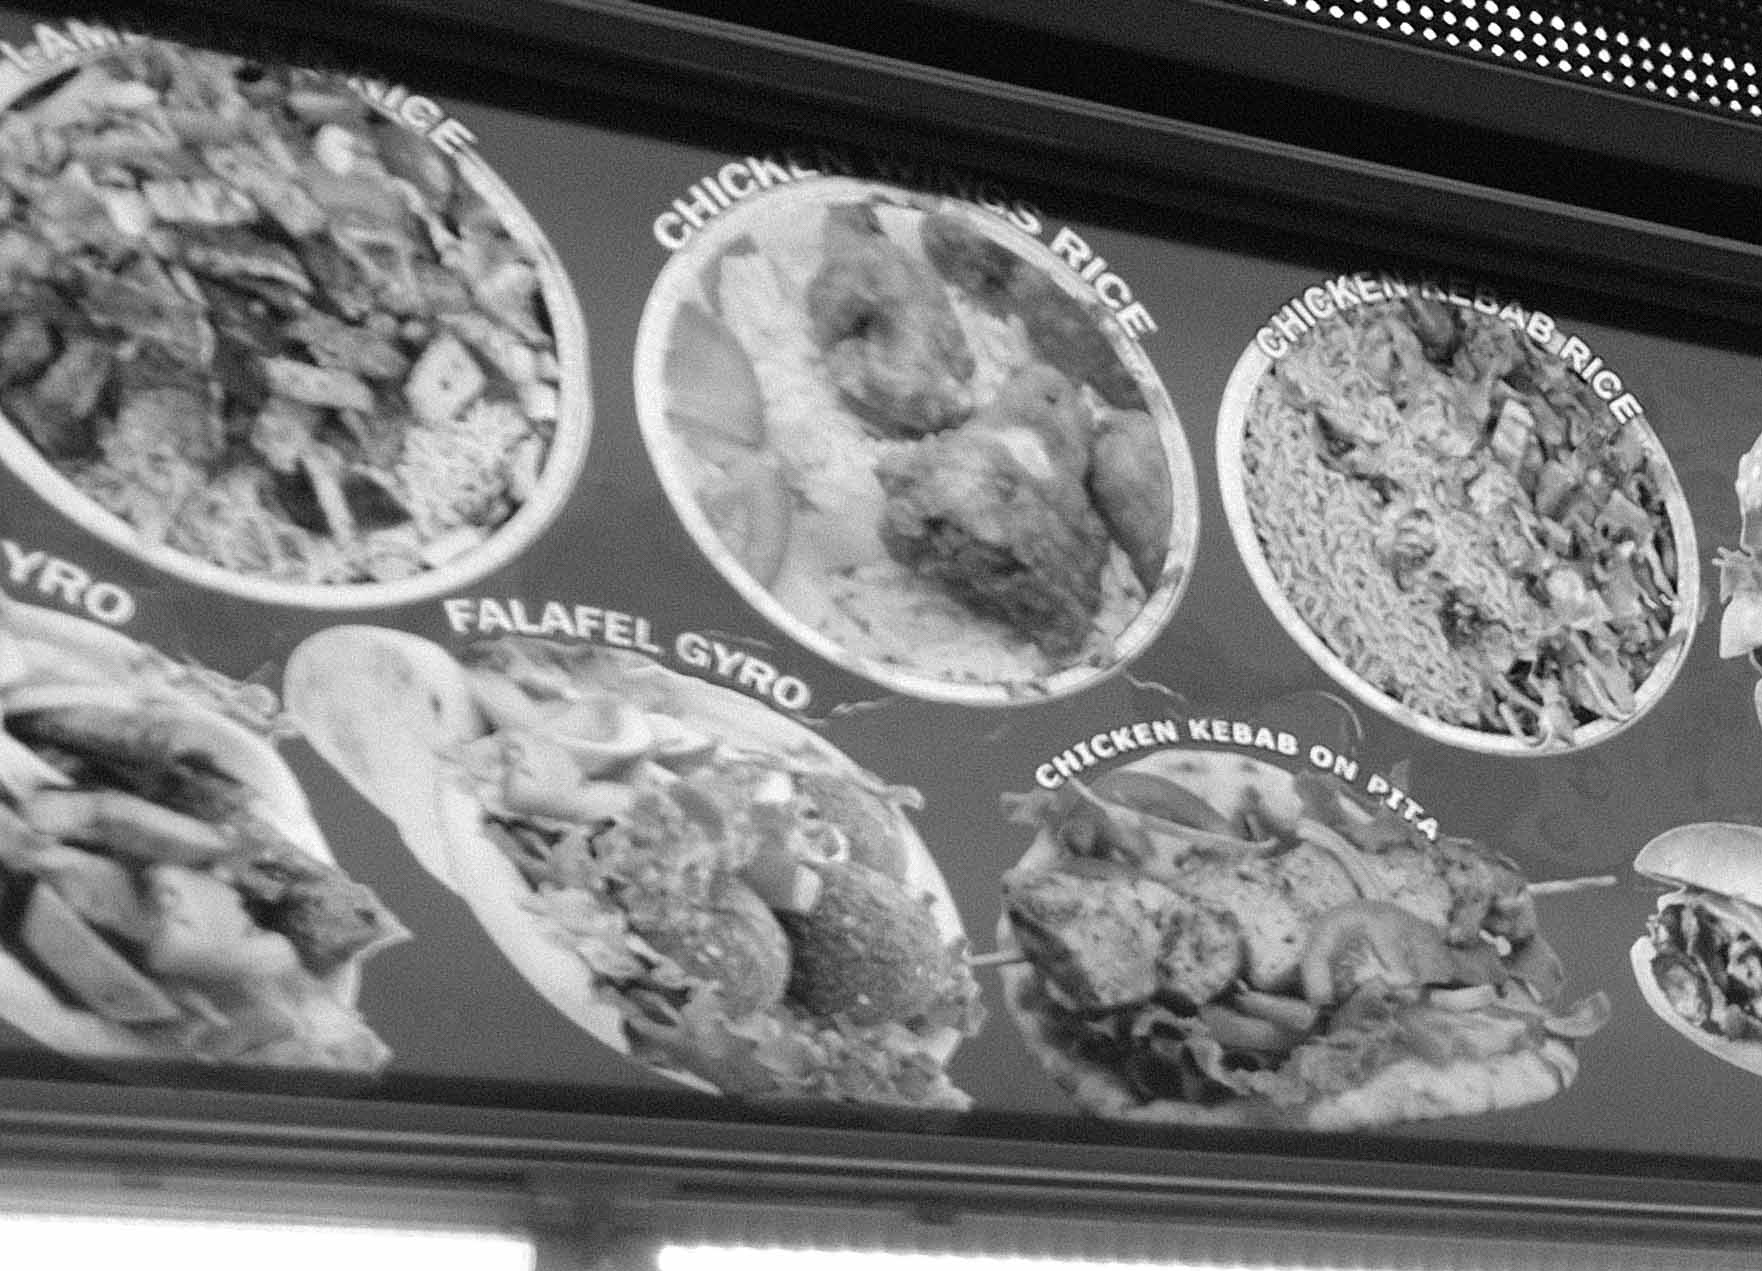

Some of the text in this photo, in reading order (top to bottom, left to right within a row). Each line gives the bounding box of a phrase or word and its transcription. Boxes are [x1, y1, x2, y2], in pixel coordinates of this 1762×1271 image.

[652, 157, 1160, 340] CHICK RICE
[1255, 274, 1408, 361] CHICKEN
[1558, 335, 1645, 445] RICE
[443, 599, 812, 711] FALAFEL GYRO
[1035, 717, 1440, 842] CHICKEN KEBAB ON PITA
